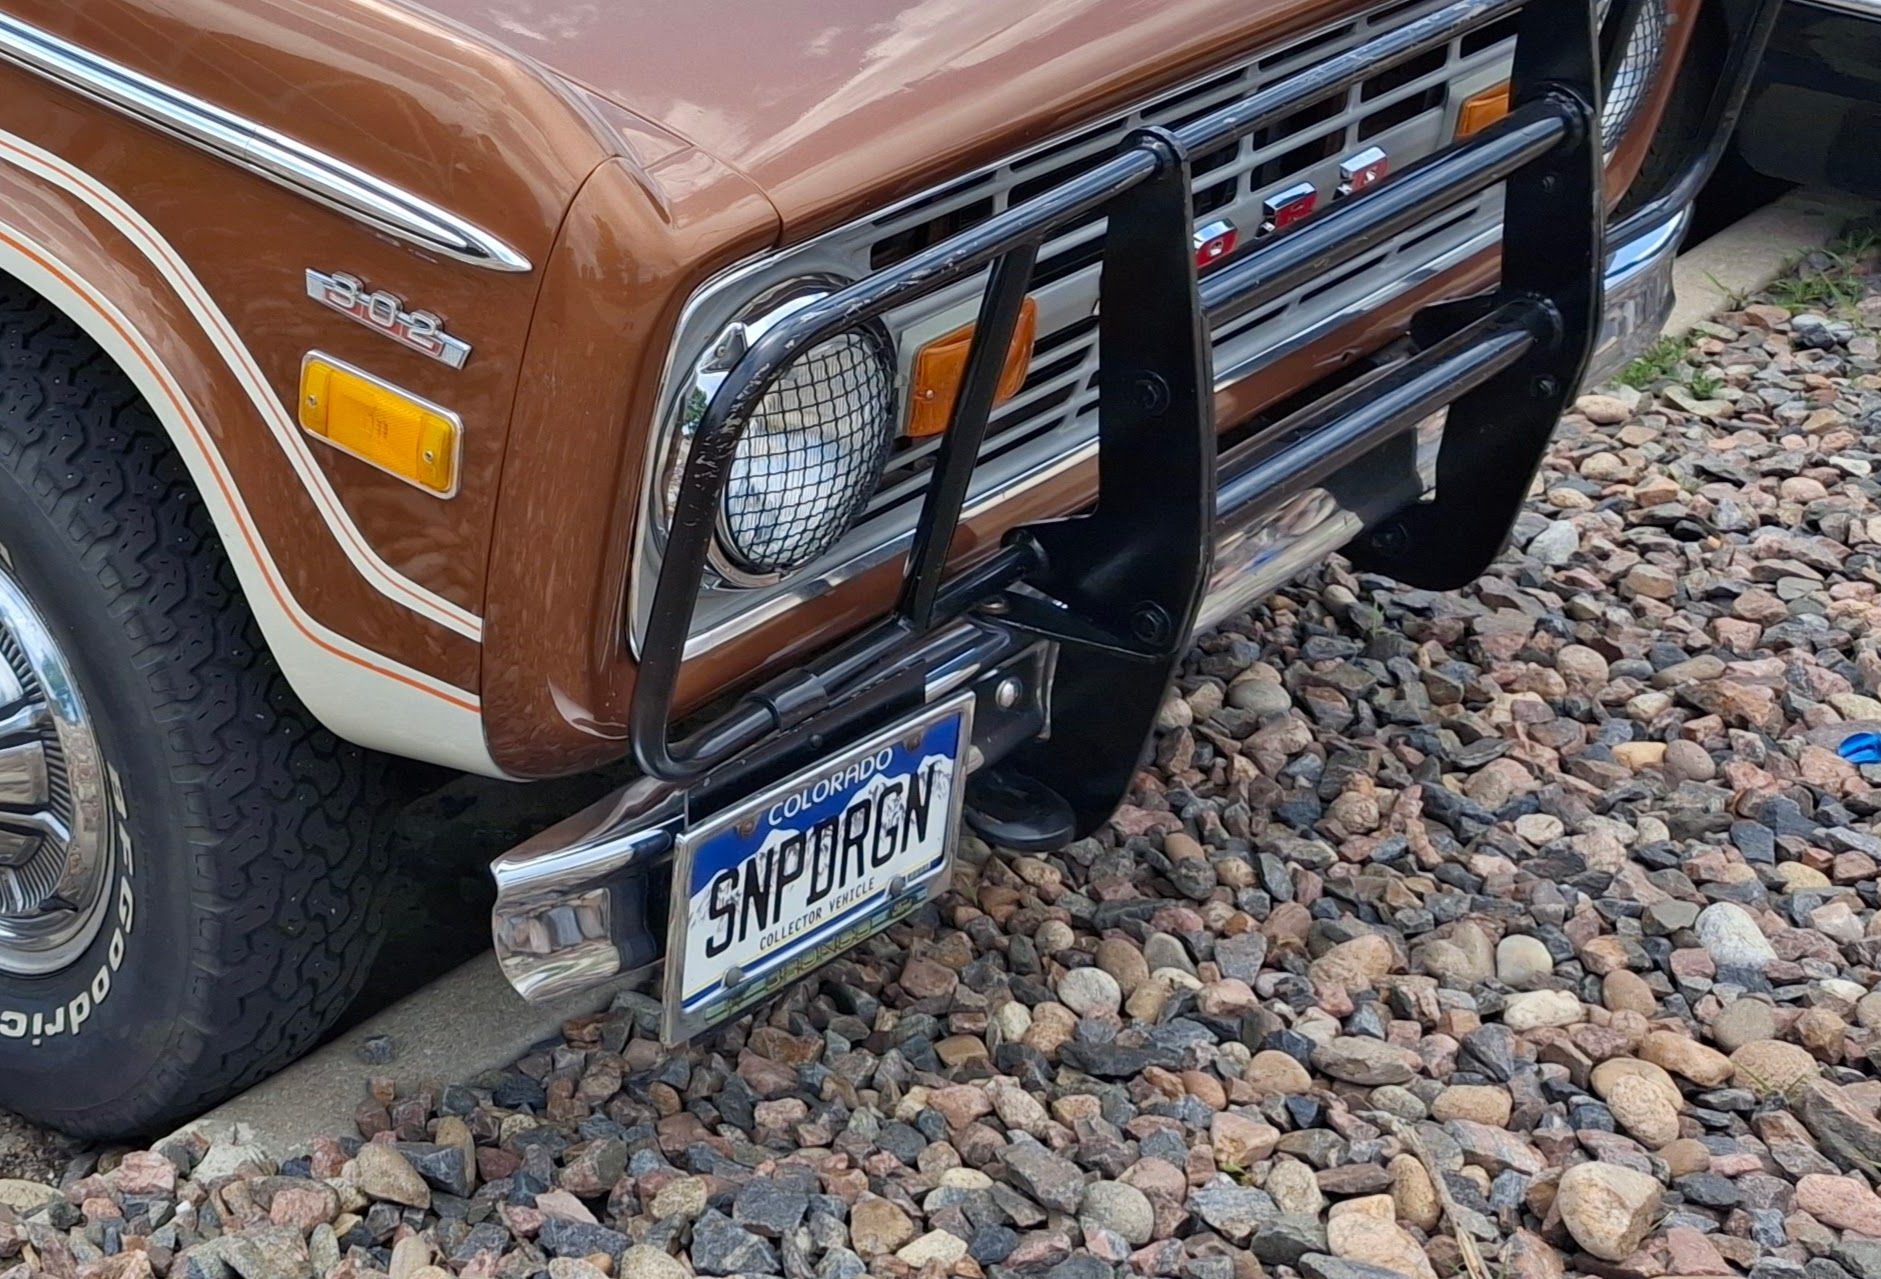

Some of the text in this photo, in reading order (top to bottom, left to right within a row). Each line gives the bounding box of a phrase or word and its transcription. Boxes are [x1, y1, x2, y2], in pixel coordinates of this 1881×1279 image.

[327, 271, 445, 350] 302
[768, 747, 893, 827] COLORADO
[705, 765, 935, 959] SNPDRGN
[759, 877, 875, 951] COLLECTOR VEHICLE
